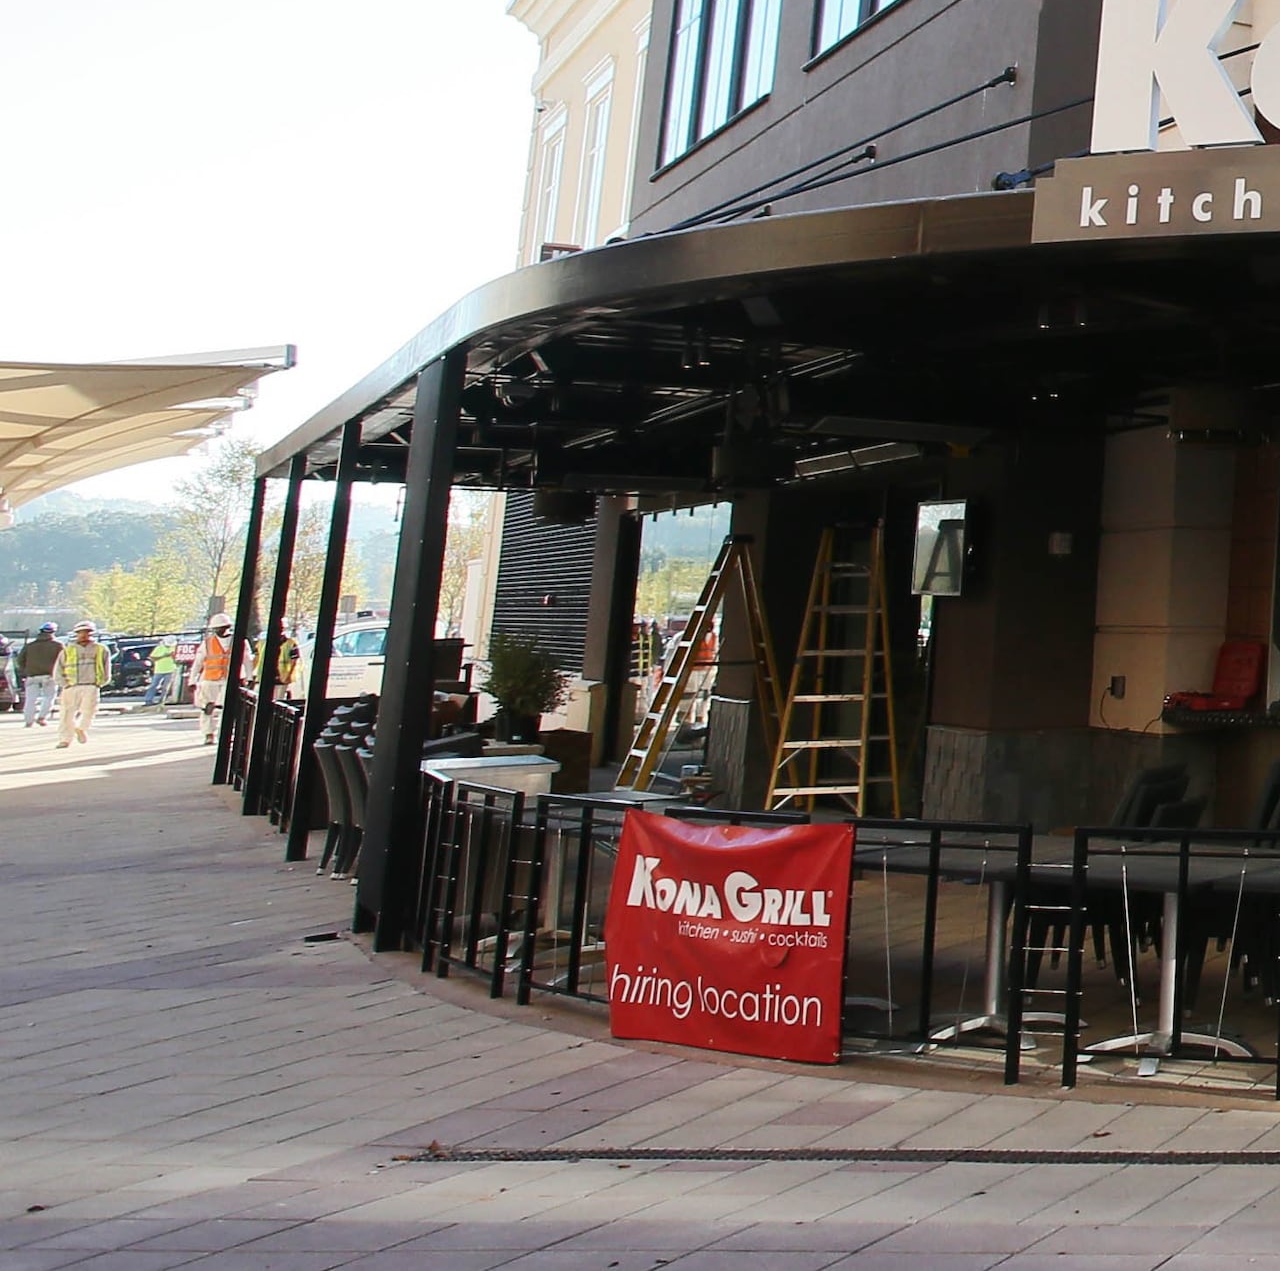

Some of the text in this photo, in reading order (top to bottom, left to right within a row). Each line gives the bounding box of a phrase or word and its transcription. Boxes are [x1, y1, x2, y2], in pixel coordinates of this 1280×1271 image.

[176, 644, 195, 654] FDC
[626, 854, 831, 926] KONA GRILL
[678, 920, 828, 948] kitchen sushi cocktails
[610, 964, 822, 1026] hiring location
